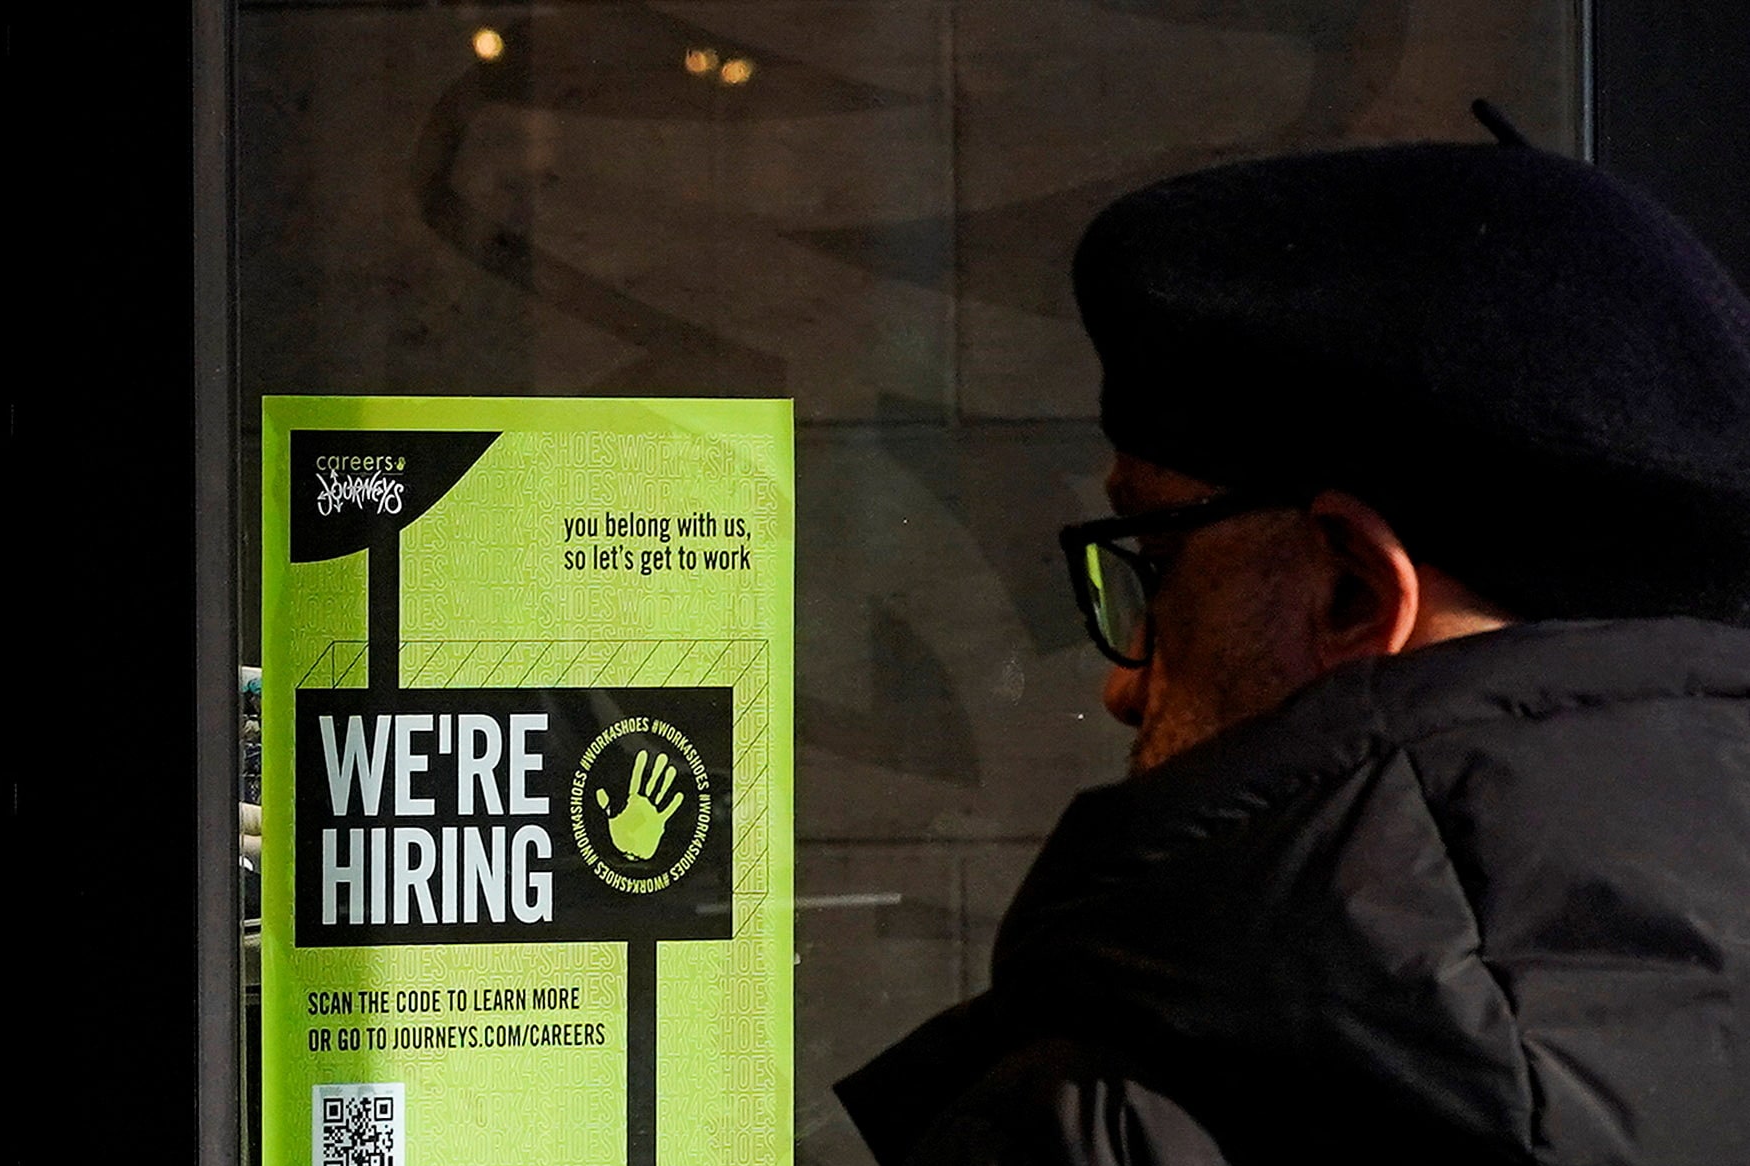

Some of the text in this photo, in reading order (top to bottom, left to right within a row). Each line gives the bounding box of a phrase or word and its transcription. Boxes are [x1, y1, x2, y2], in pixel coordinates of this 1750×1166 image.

[316, 456, 394, 471] careers
[316, 470, 404, 516] JOURNEYS
[564, 517, 598, 543] you
[605, 511, 671, 543] belong
[677, 511, 717, 538] with
[724, 518, 751, 541] us,
[564, 550, 586, 571] so
[593, 545, 634, 571] let's
[640, 546, 672, 576] get
[677, 545, 697, 571] to
[703, 545, 751, 571] work
[318, 713, 550, 817] WE'RE
[579, 717, 649, 771] #WORK4SHOES
[651, 719, 710, 791] #WORK4SHOES
[570, 770, 600, 866] #WORK4SHOES
[670, 793, 712, 881] #WORK4SHOES
[322, 824, 553, 925] HIRING
[594, 860, 671, 894] #WORK4SHOES
[307, 987, 580, 1016] SCAN THE CODE TO LEARN MORE
[308, 1022, 606, 1053] OR GO TO JOURNEYS.COM/CAREERS
